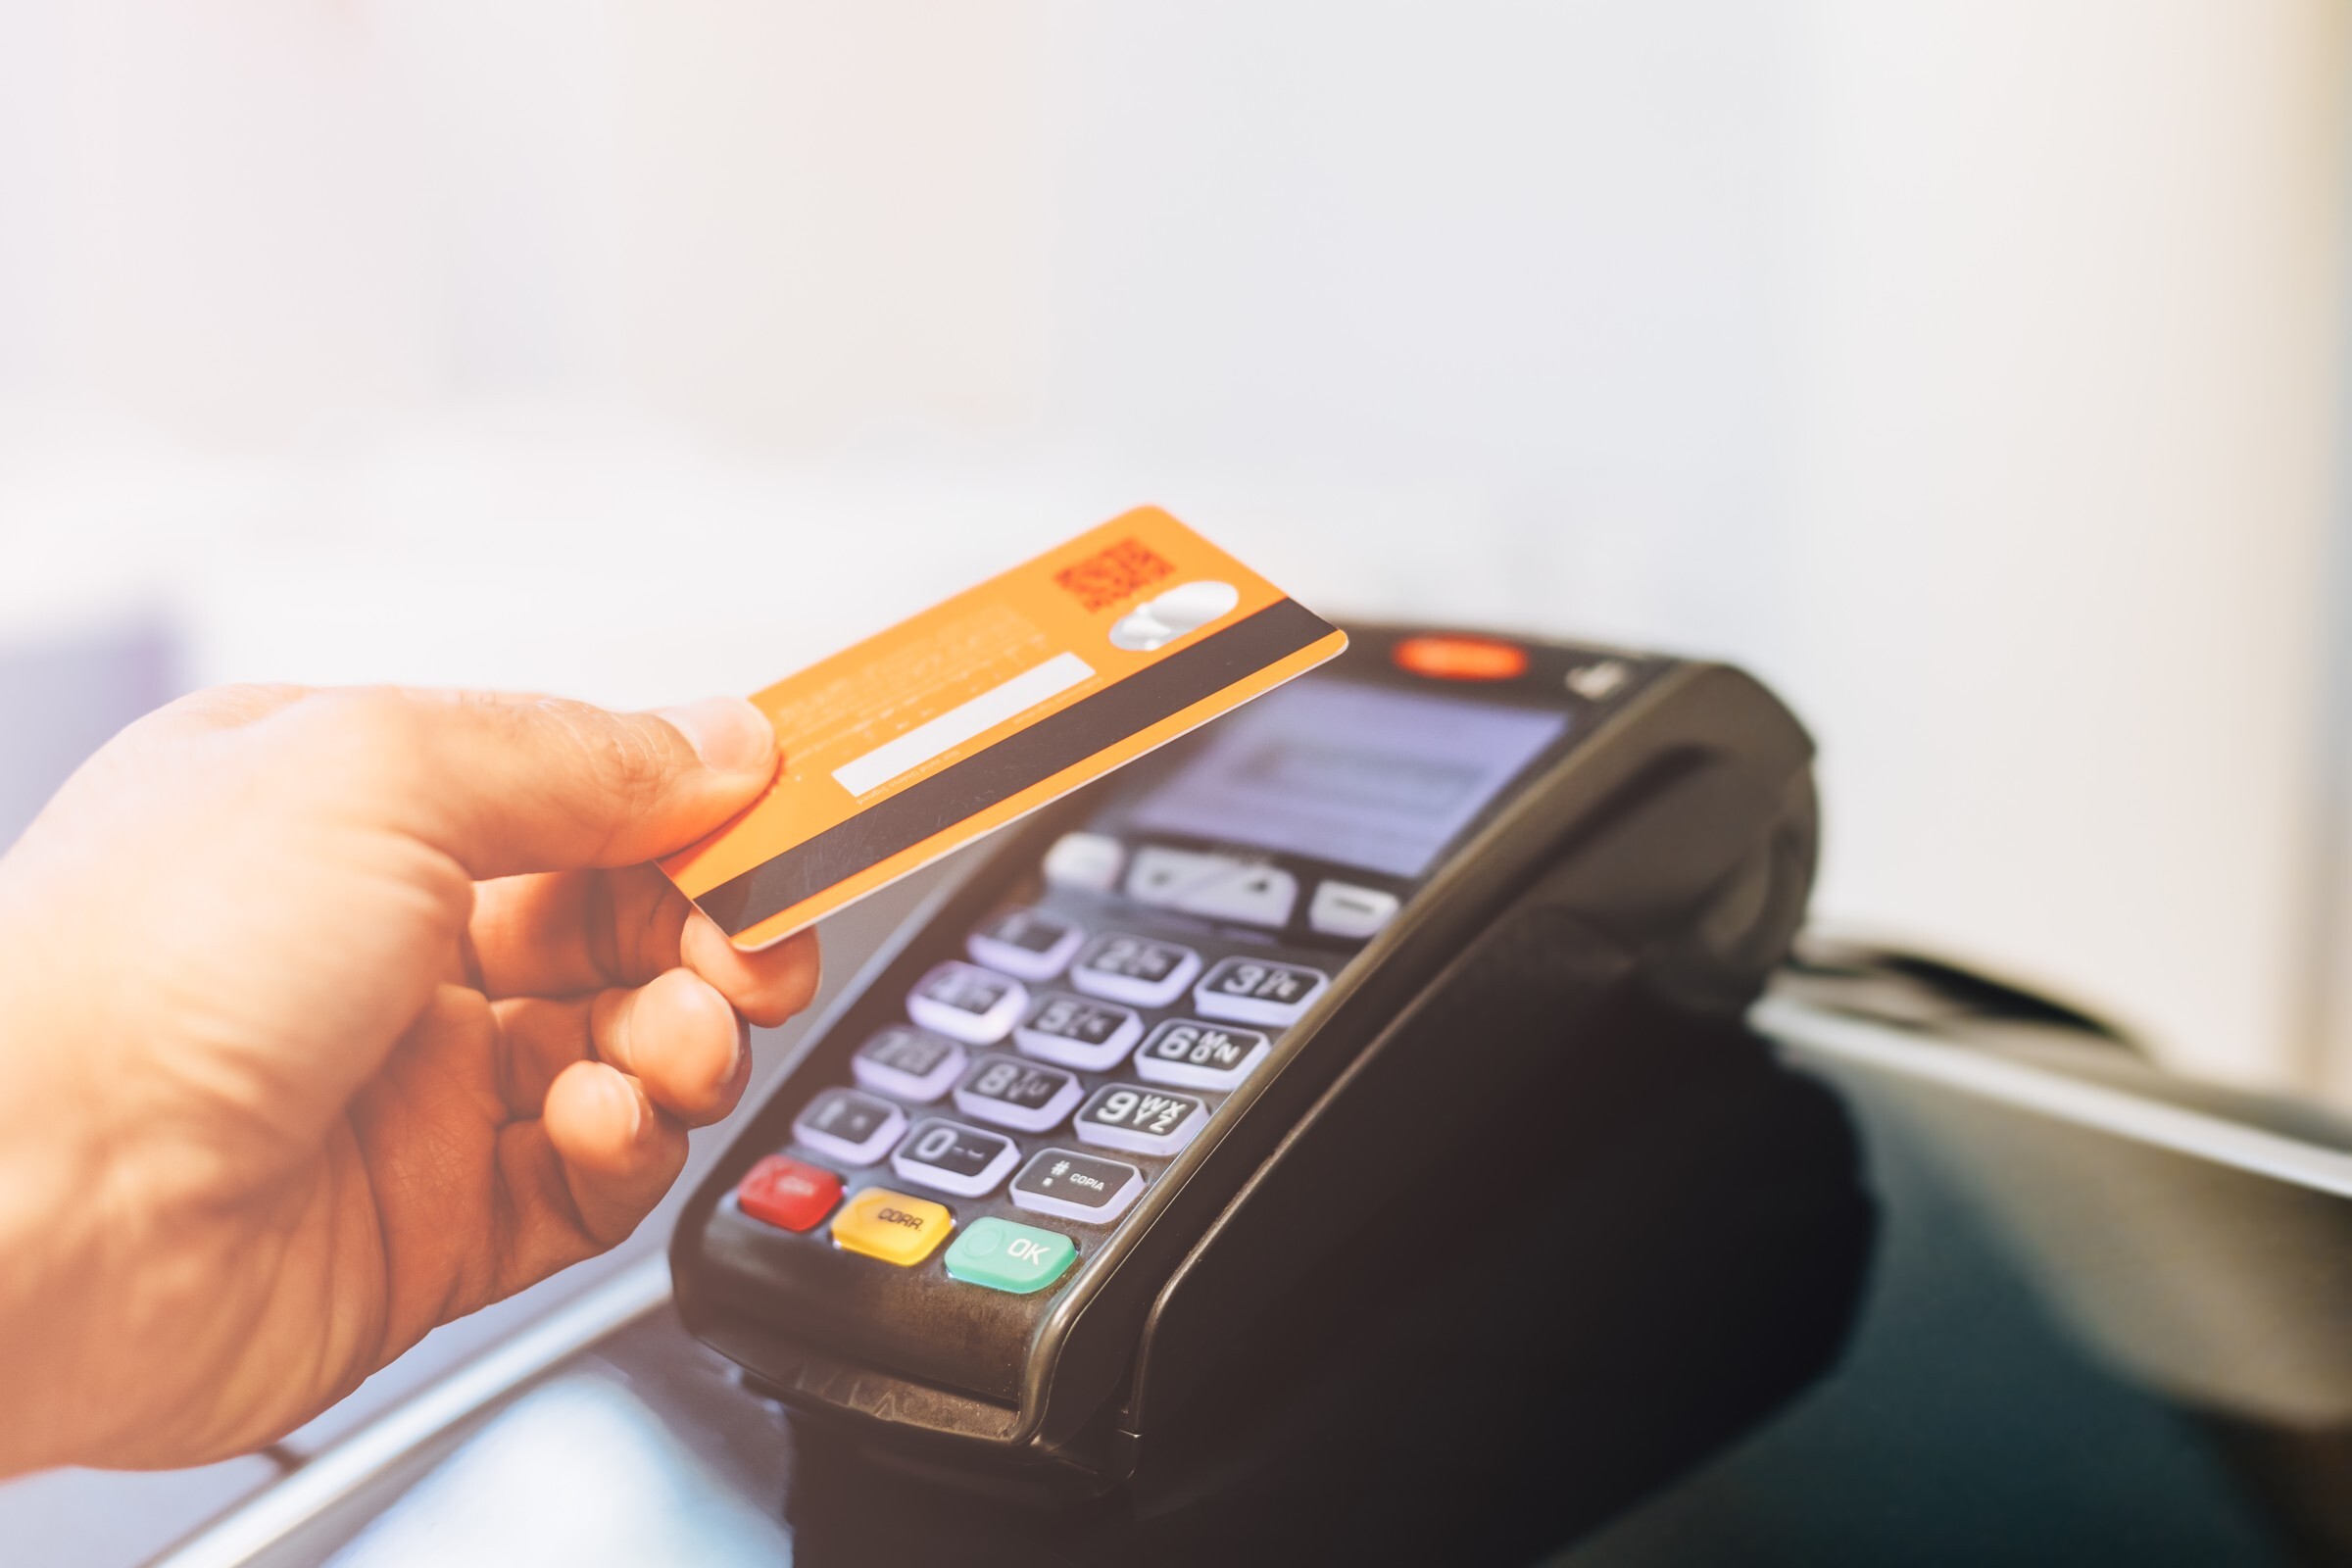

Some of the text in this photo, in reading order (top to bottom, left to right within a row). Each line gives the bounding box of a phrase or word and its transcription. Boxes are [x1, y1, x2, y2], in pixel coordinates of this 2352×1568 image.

[856, 784, 891, 806] Signed
[1223, 964, 1265, 994] 3
[1037, 1001, 1078, 1031] 5
[1157, 1026, 1200, 1058] 6
[977, 1063, 1019, 1095] 8
[1097, 1091, 1140, 1123] 9
[1069, 1173, 1104, 1191] COPIA
[1007, 1238, 1052, 1266] OK
